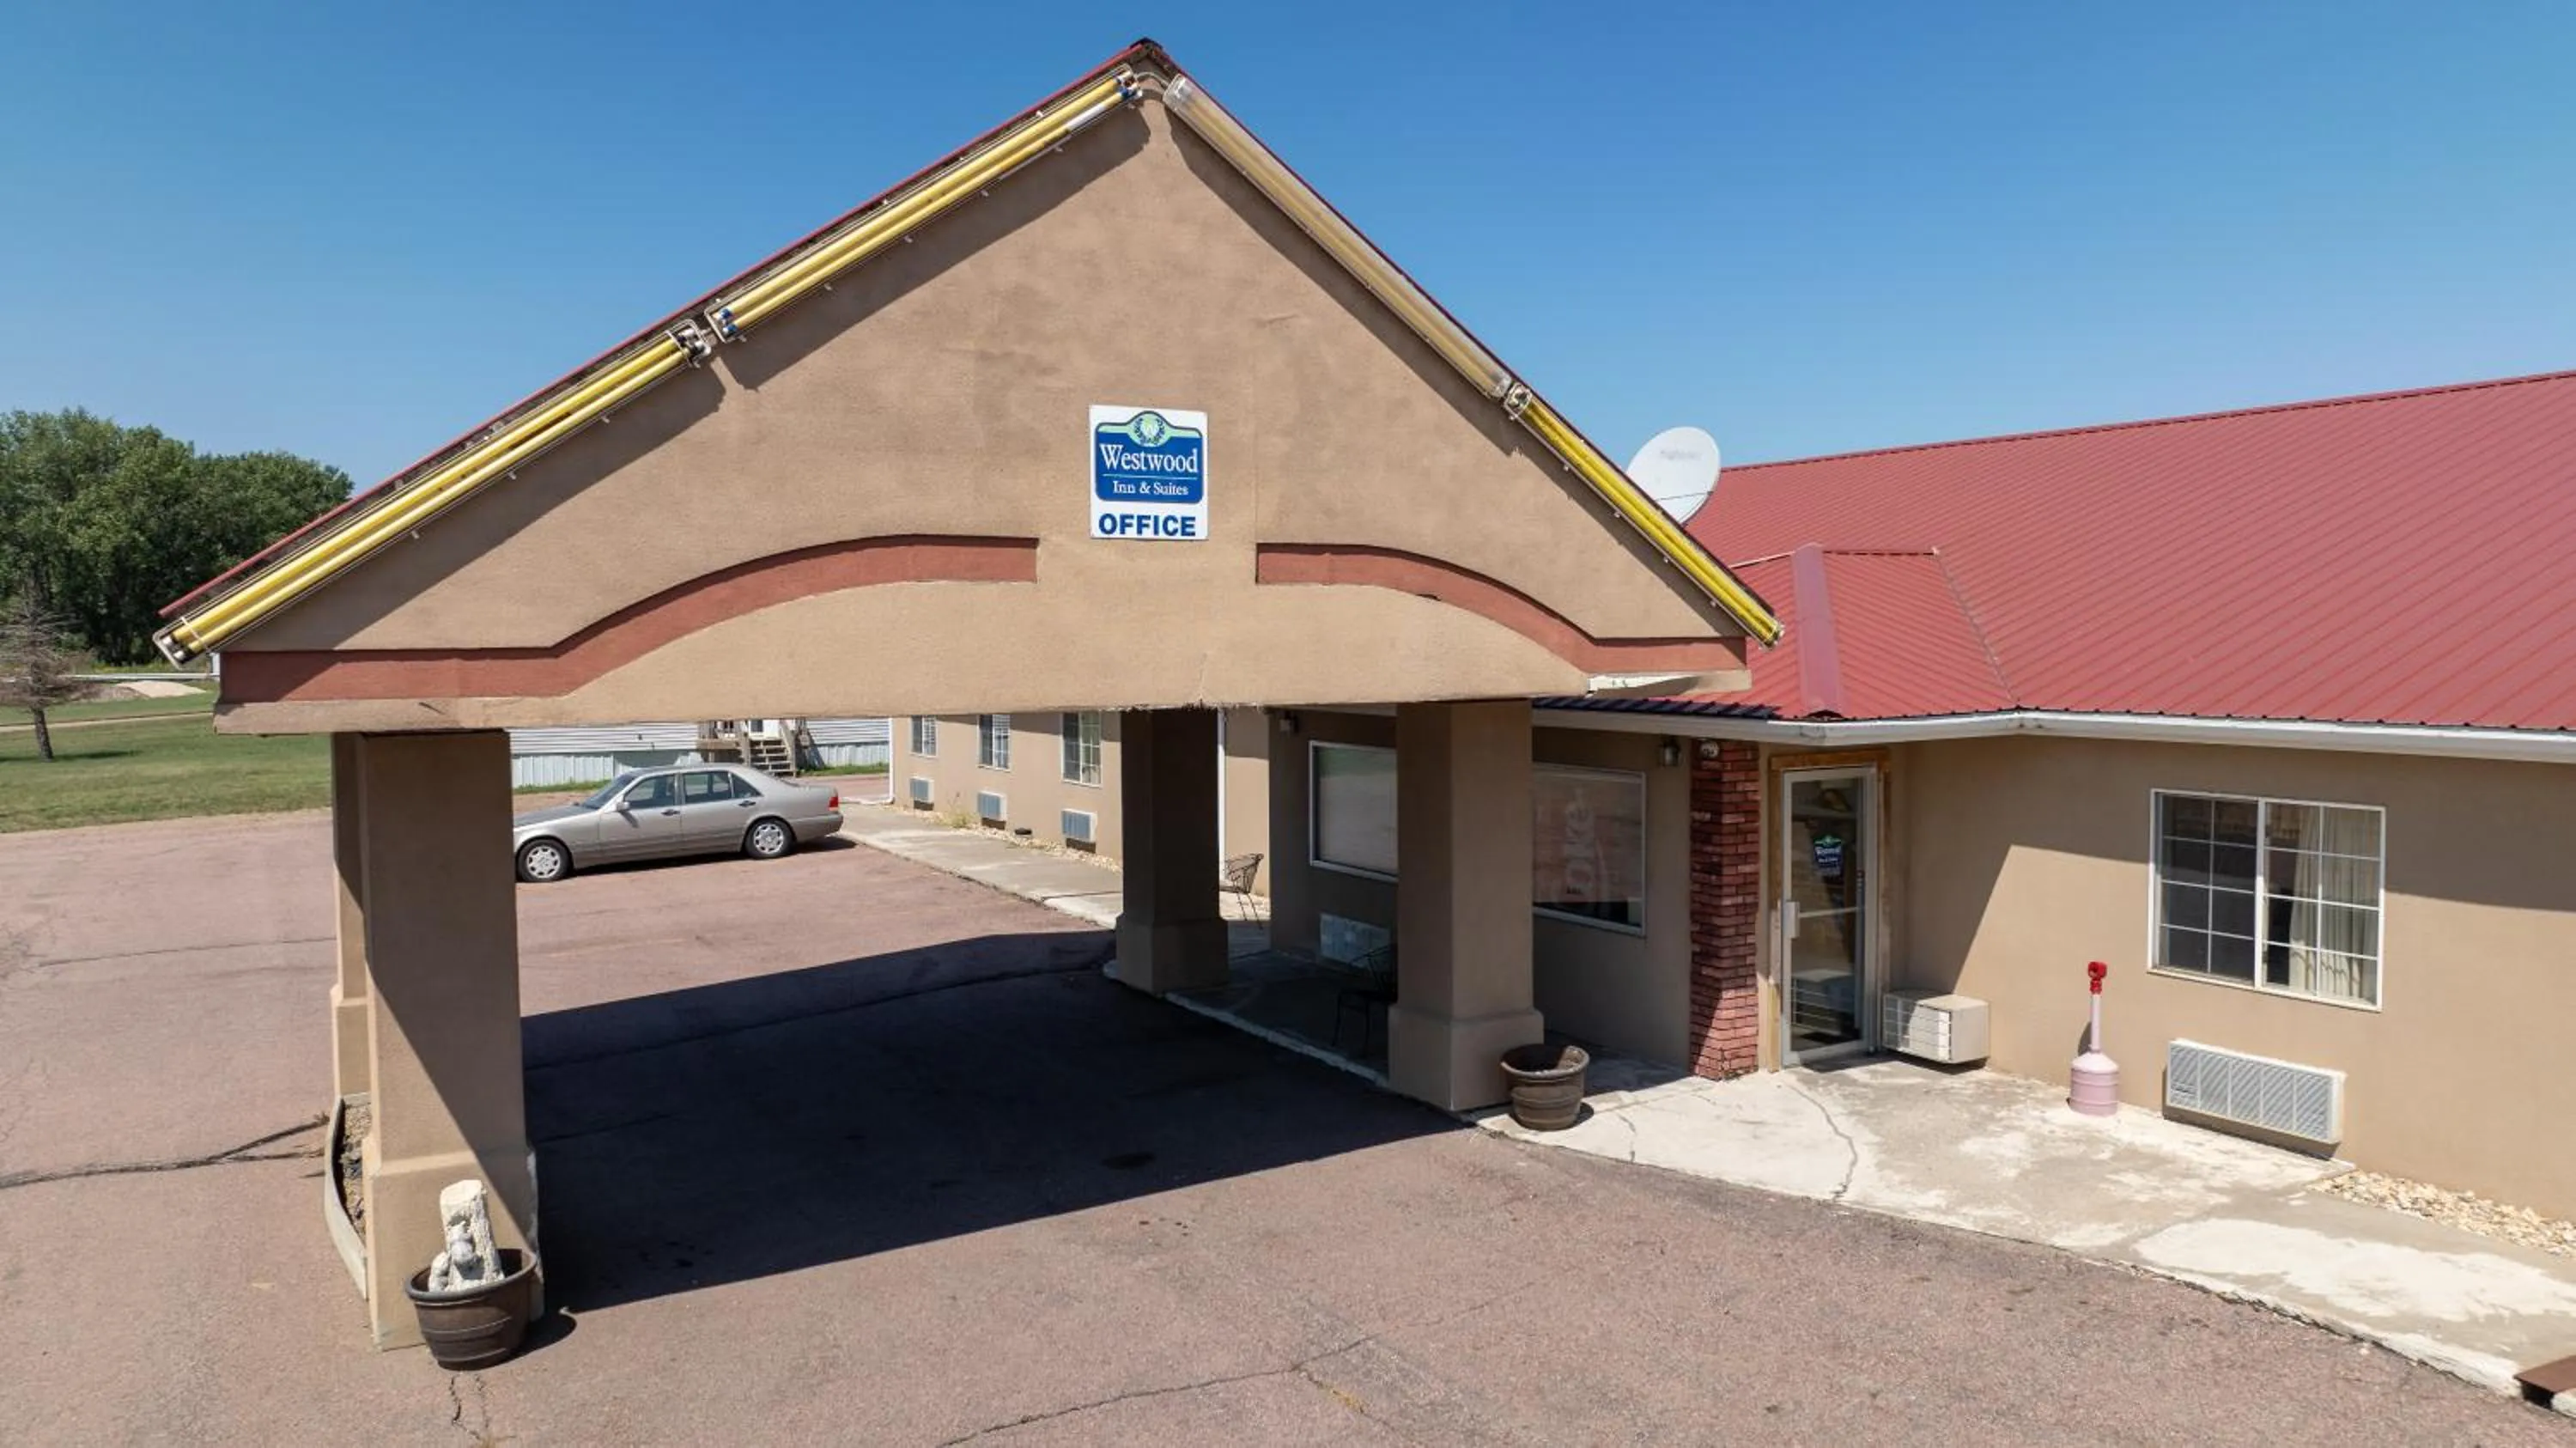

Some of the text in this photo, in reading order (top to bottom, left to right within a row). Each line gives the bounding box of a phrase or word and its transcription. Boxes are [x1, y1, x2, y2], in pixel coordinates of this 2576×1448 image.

[1098, 443, 1199, 473] Westwood
[1113, 480, 1189, 496] Inn & Suites
[1098, 513, 1196, 537] OFFICE
